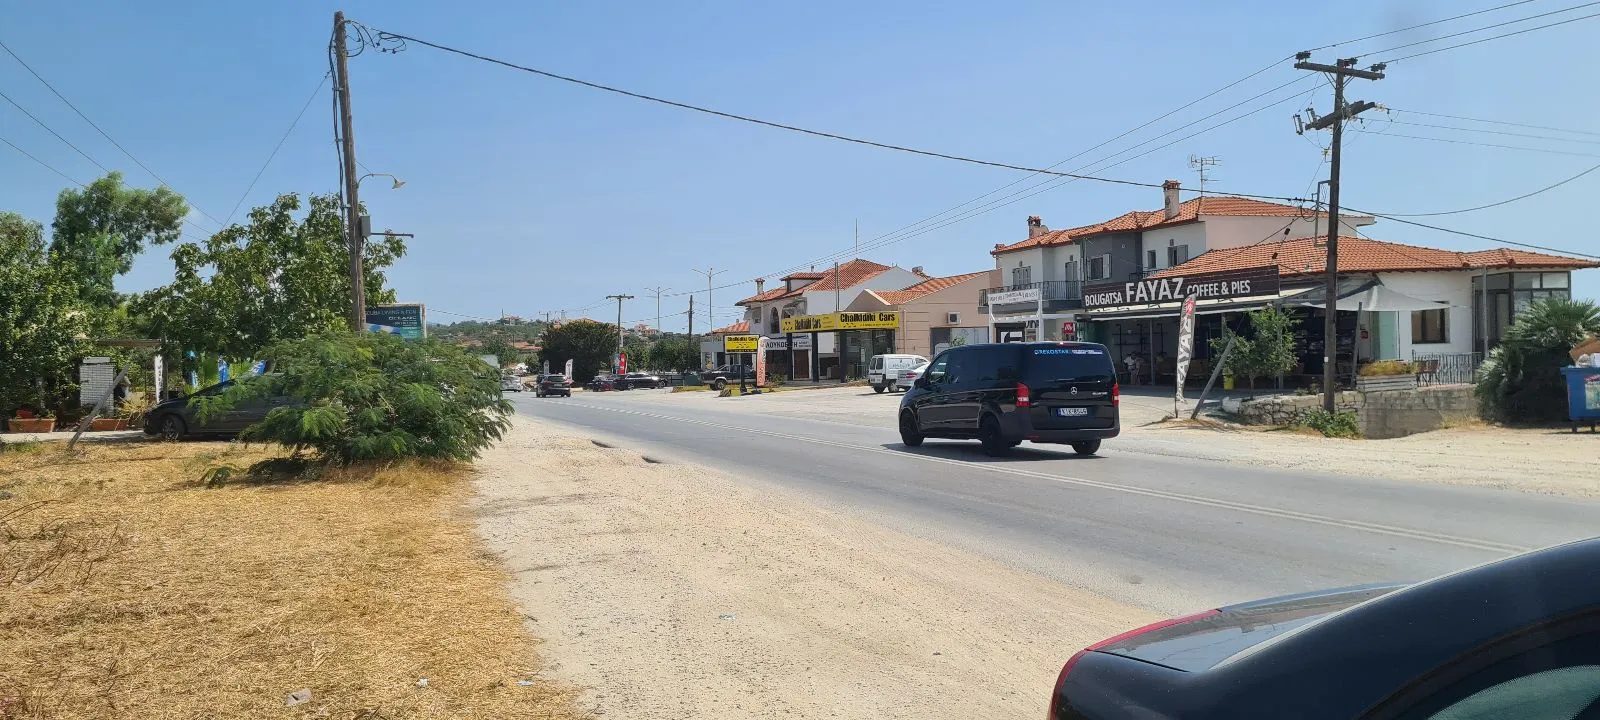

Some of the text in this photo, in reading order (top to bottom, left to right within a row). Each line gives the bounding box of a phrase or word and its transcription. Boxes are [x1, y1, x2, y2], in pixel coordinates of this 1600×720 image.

[1085, 277, 1251, 307] BOUGATSA FAYAZ COFFEE & PIES
[840, 313, 876, 323] Chalkidiki
[879, 312, 895, 322] Cars
